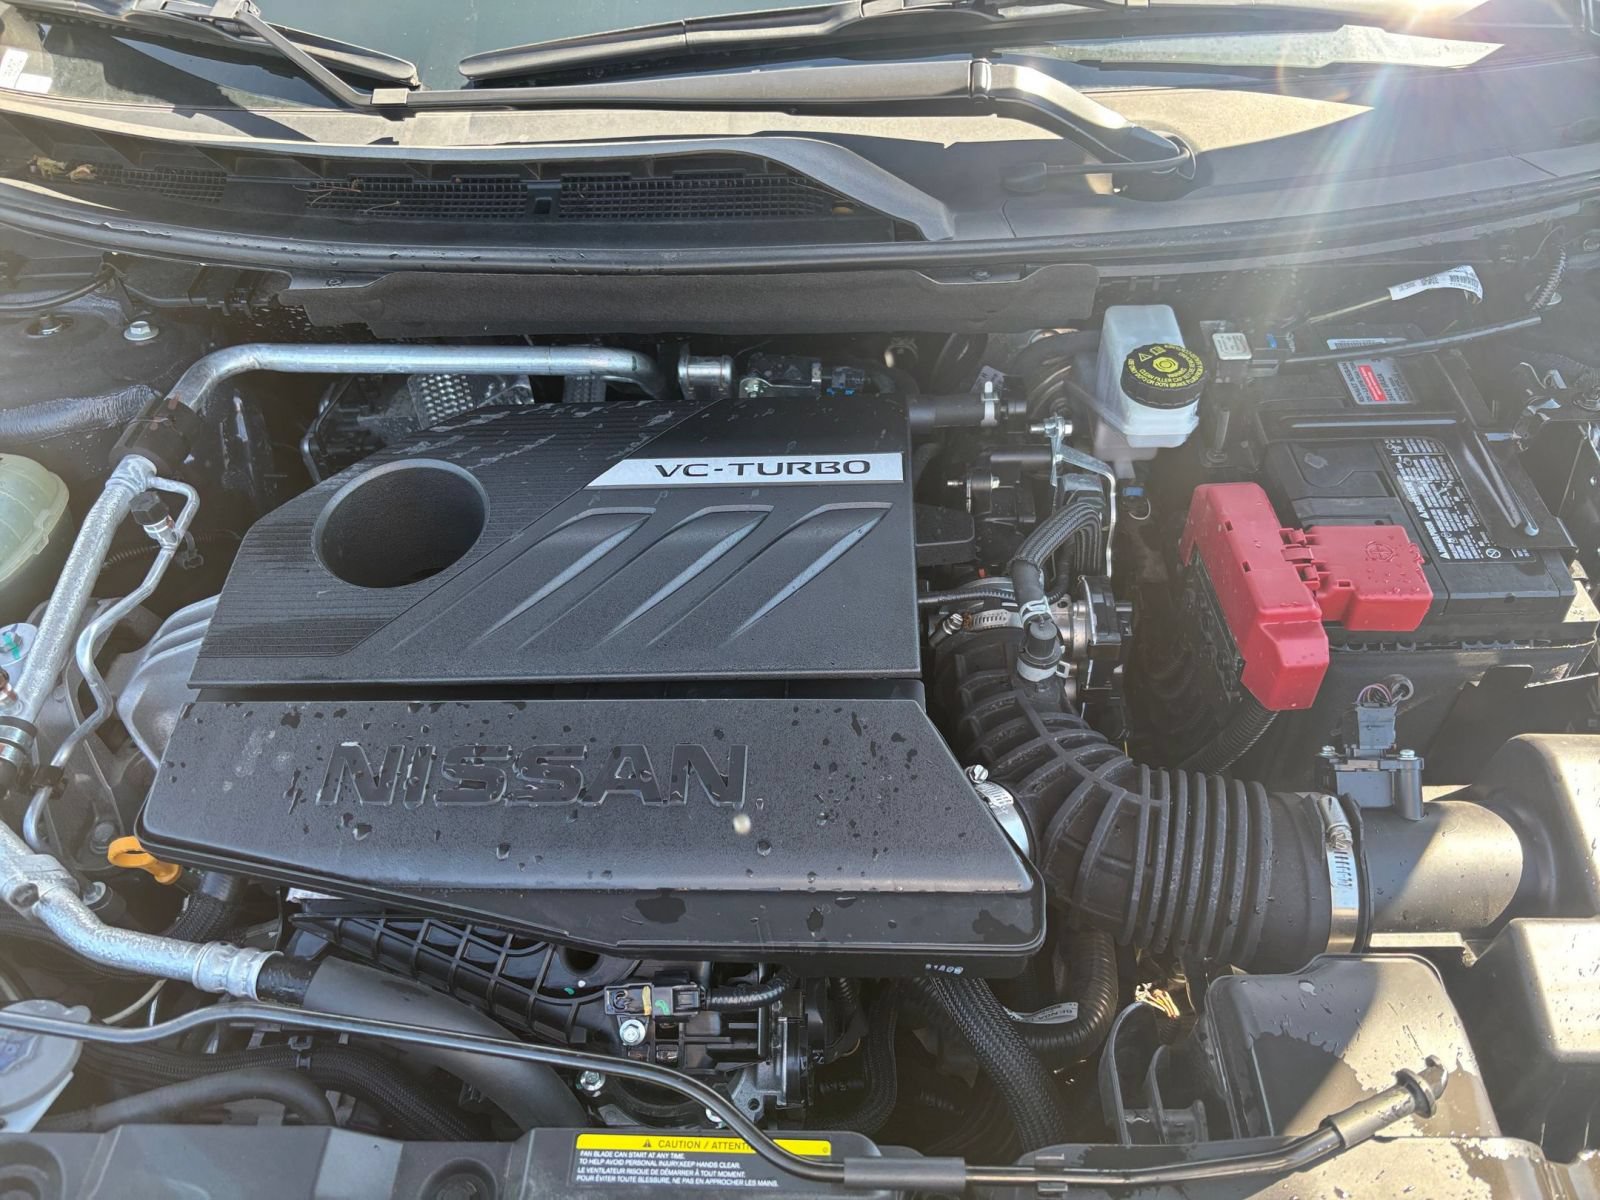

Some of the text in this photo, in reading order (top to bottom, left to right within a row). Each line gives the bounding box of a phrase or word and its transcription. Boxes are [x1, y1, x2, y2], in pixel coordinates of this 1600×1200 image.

[655, 460, 871, 477] VC-TURBO
[315, 743, 749, 808] NISSAN
[658, 1140, 700, 1150] CAUTION
[625, 1159, 657, 1167] PERSONAL
[660, 1167, 694, 1176] DÉMARRER
[595, 1174, 616, 1182] ÉVITER
[704, 1178, 743, 1186] APPROCHER
